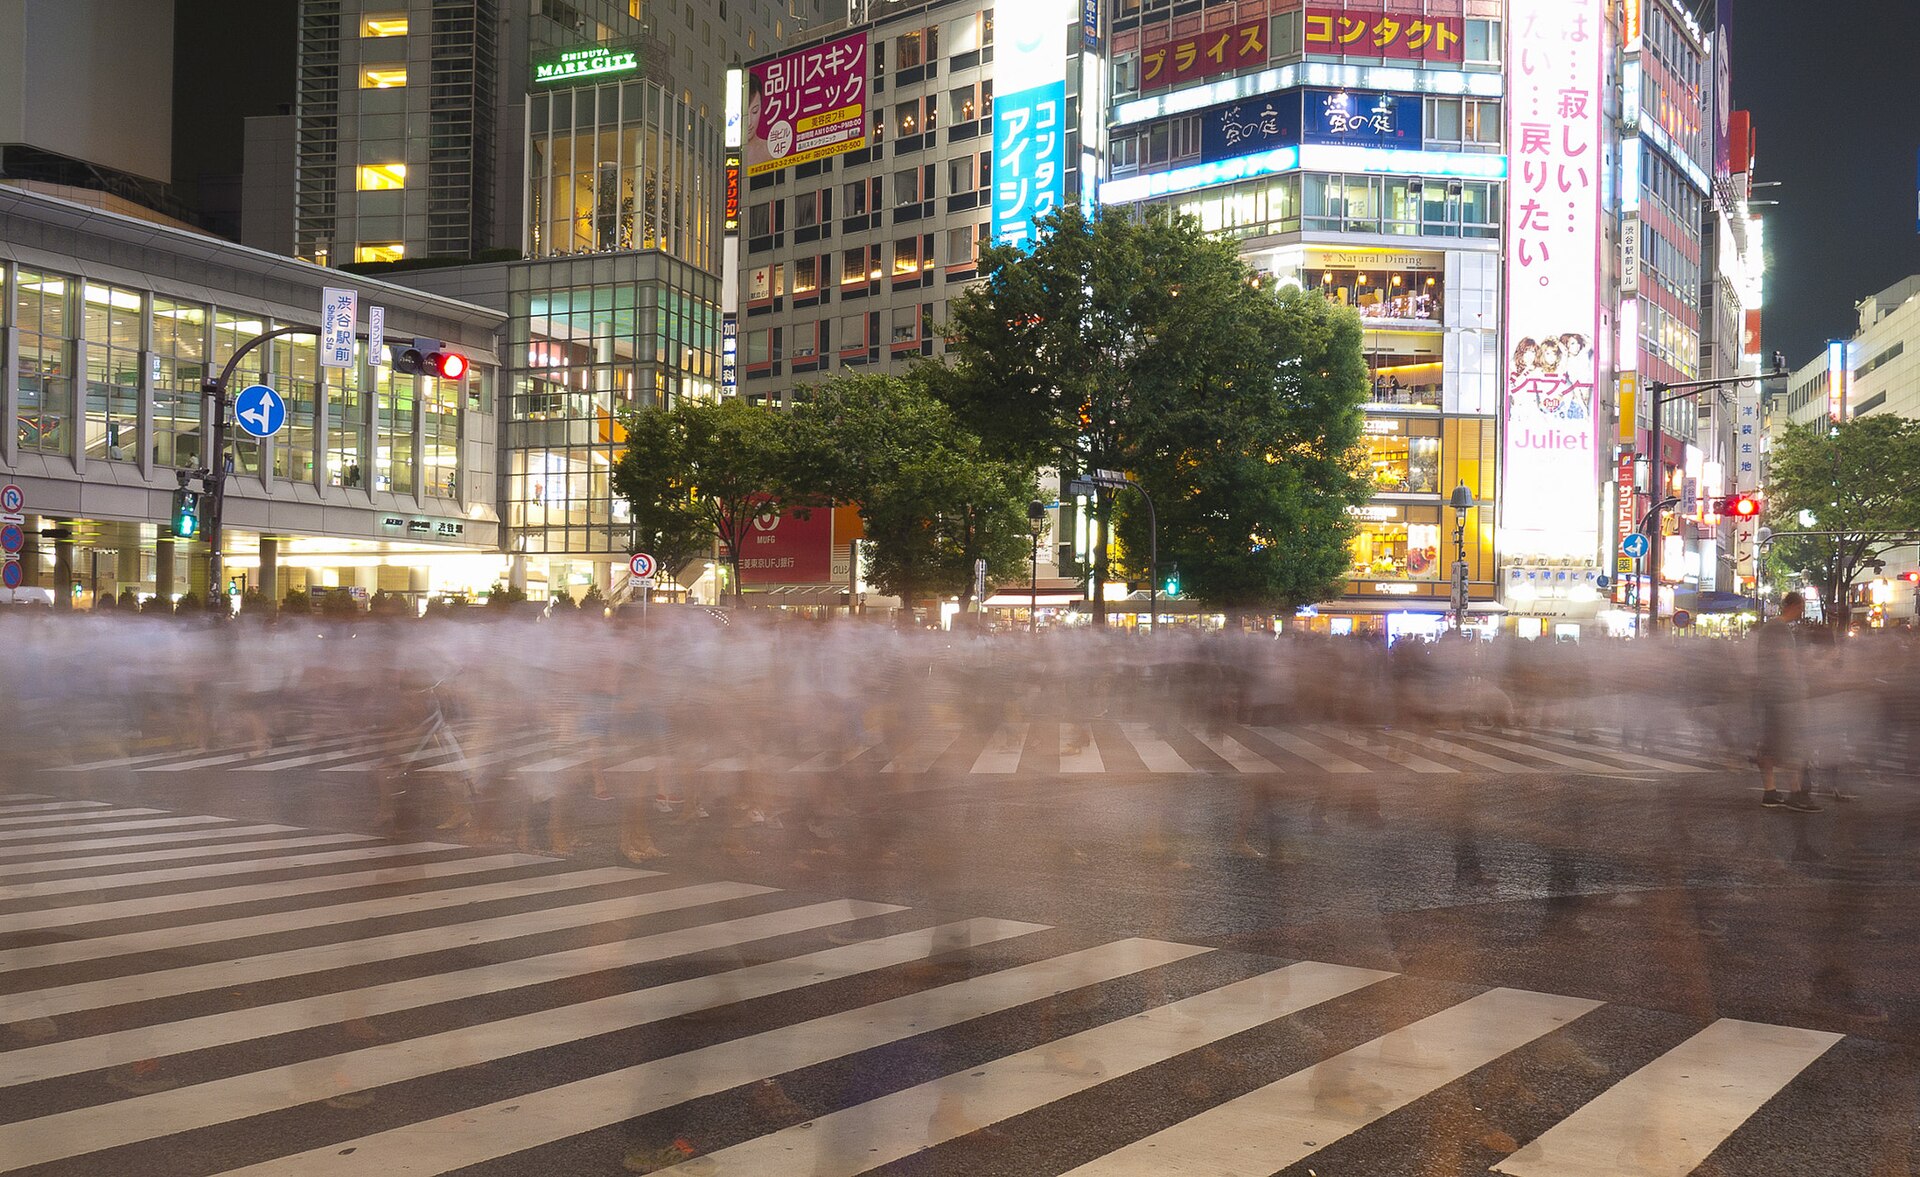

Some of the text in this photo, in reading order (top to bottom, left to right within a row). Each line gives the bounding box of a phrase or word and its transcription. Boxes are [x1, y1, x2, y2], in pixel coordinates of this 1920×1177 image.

[1306, 15, 1458, 51] コンタクト
[537, 53, 635, 77] MARK CITY
[561, 48, 610, 62] SHIBUYA
[764, 43, 864, 97] 品川スキン
[1143, 24, 1263, 81] プライス
[765, 73, 863, 125] クリニック
[770, 127, 790, 141] 当ビル
[773, 141, 786, 155] 4F
[727, 169, 738, 218] アメリカン
[1338, 253, 1422, 266] Natural Dining
[1624, 226, 1634, 285] 渋谷駅前ビル
[325, 304, 336, 353] Shibuya Sta.
[335, 295, 352, 362] 渋谷駅前
[1515, 429, 1588, 450] Juliet
[757, 535, 775, 544] MUFG
